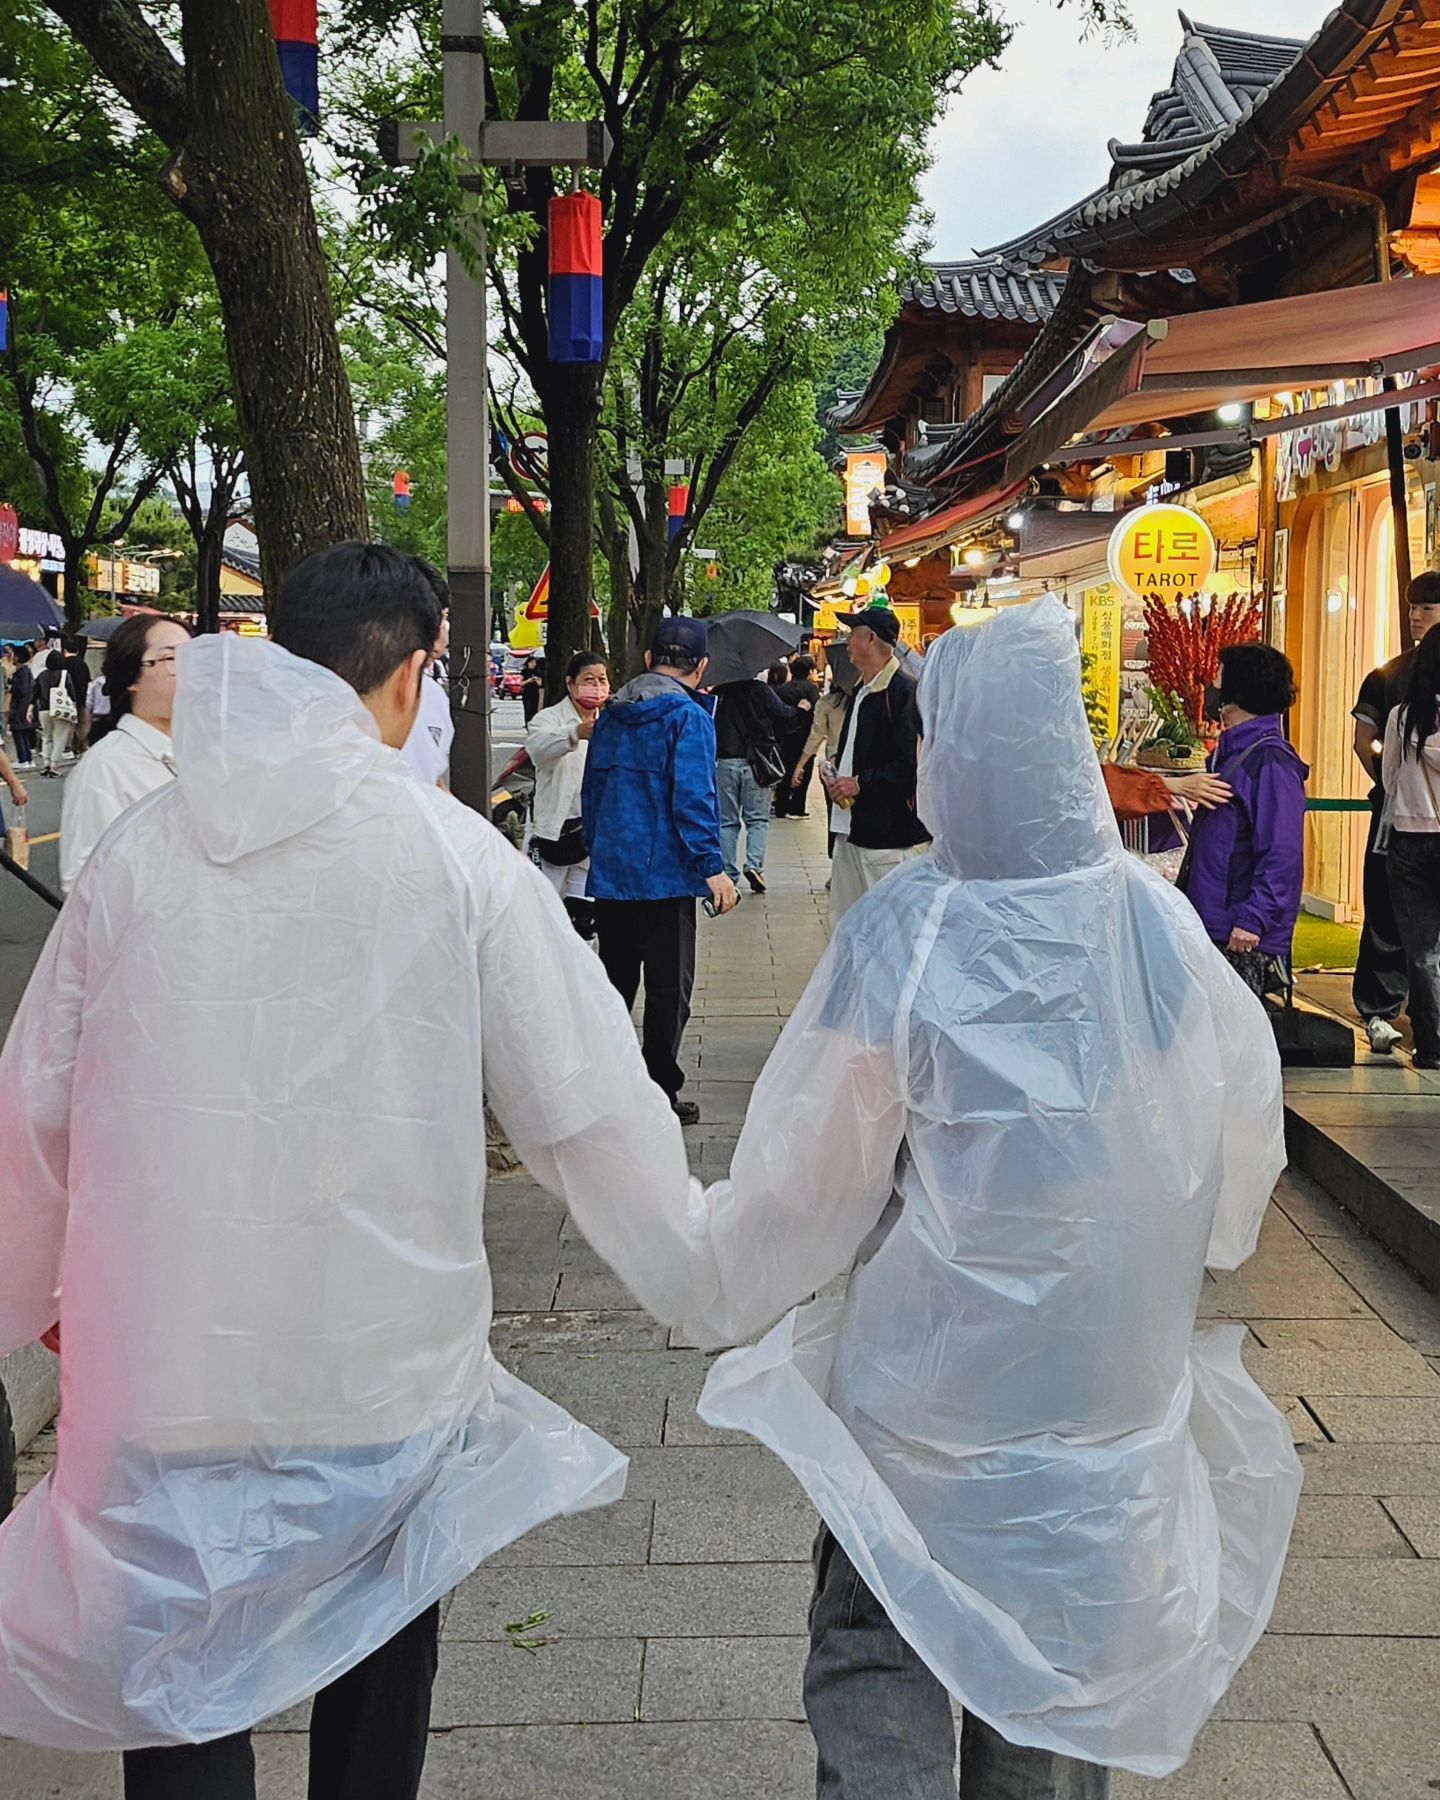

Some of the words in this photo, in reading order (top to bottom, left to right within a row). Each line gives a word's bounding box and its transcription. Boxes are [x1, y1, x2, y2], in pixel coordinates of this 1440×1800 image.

[1134, 529, 1200, 563] 타로
[1134, 572, 1198, 587] TAROT
[1089, 595, 1115, 607] KBS
